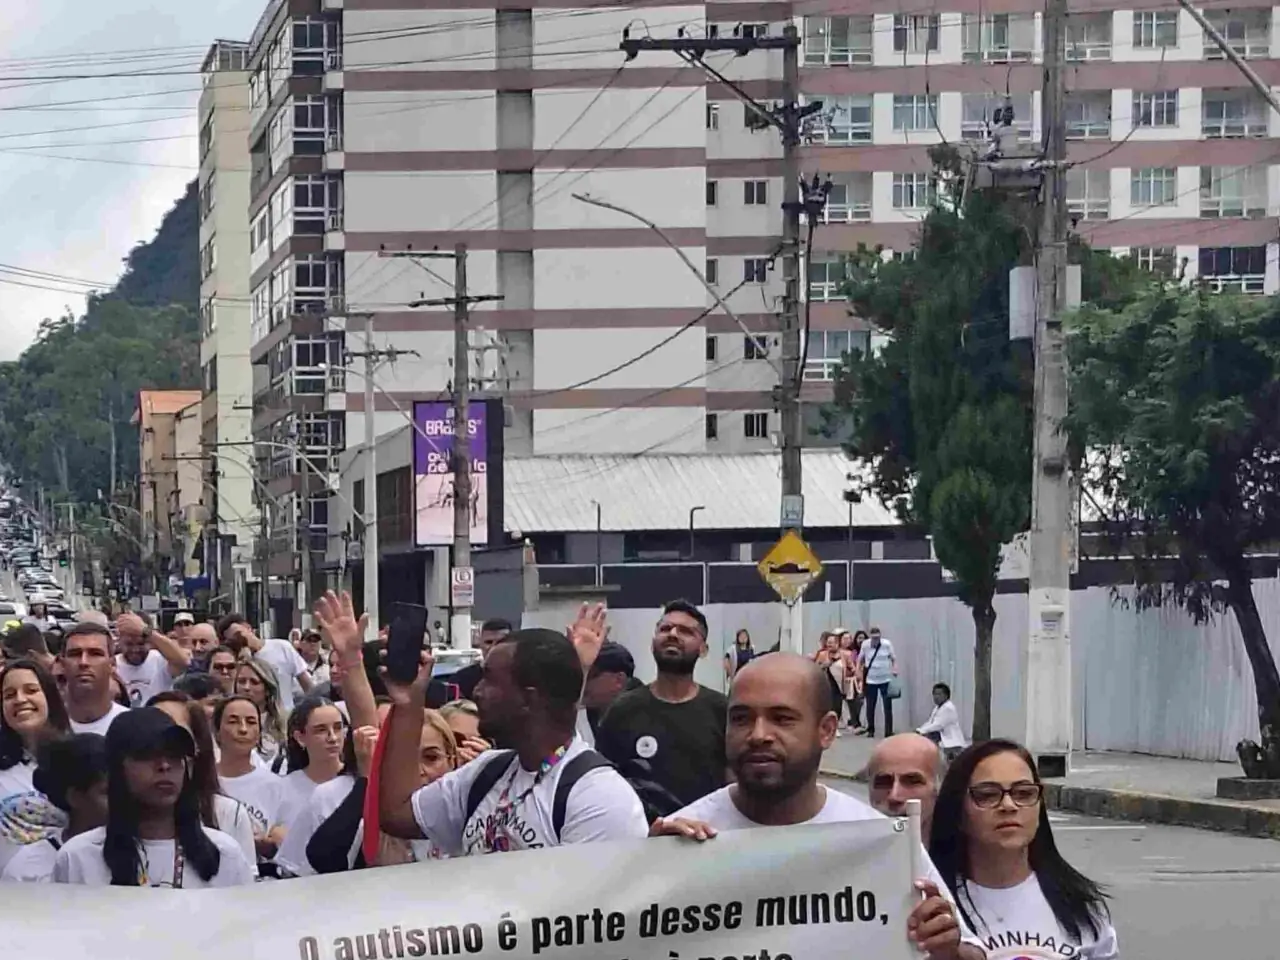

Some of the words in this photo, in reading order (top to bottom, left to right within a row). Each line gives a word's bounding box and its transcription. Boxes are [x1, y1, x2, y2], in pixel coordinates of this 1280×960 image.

[497, 912, 517, 950] é
[531, 907, 626, 954] parte
[639, 900, 742, 938] desse
[756, 886, 888, 927] mundo,
